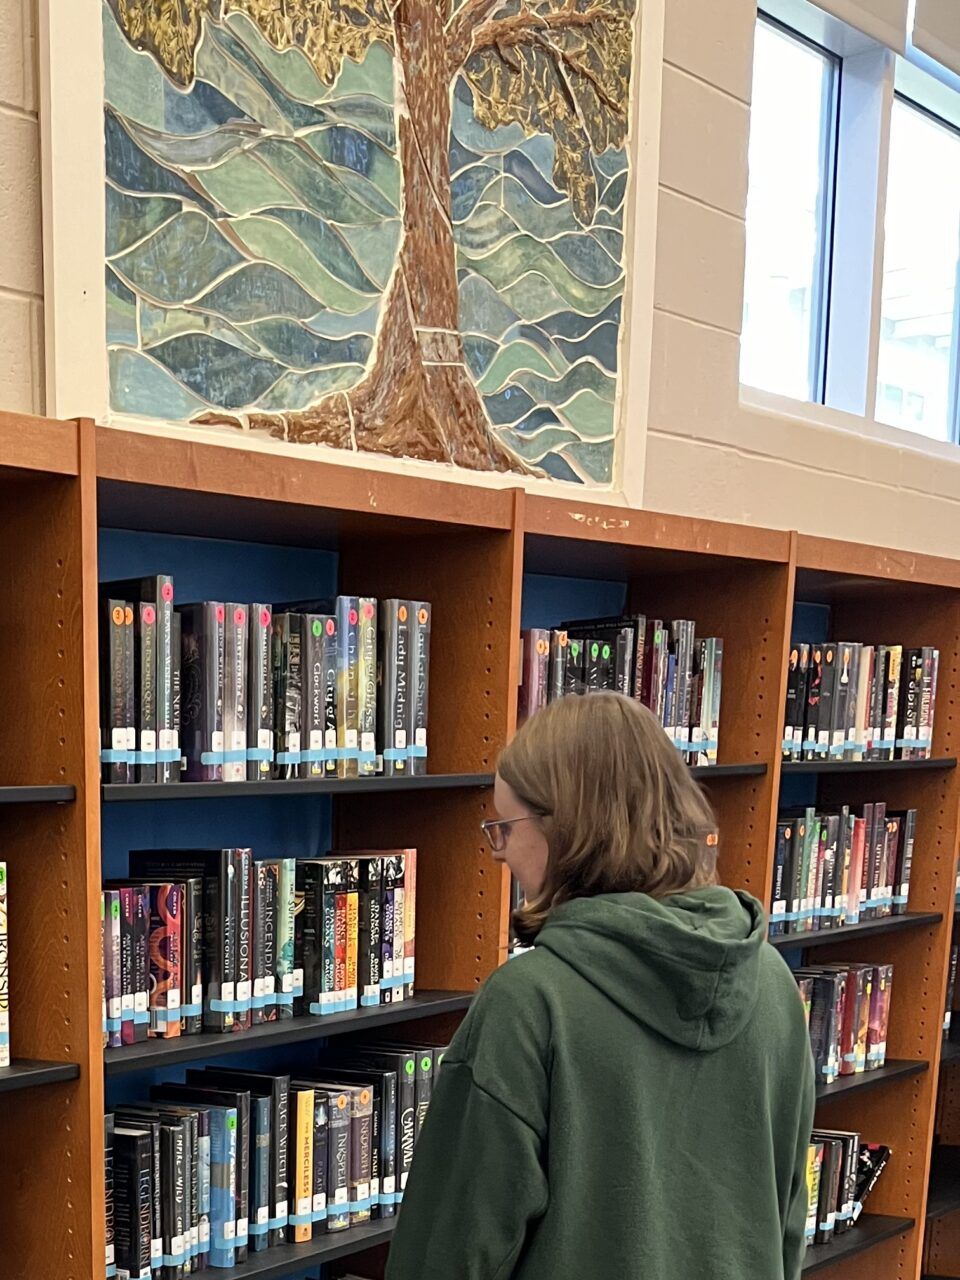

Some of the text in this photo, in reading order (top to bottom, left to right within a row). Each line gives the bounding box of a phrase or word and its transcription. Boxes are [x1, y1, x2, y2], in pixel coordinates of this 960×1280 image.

[365, 626, 375, 661] City
[396, 624, 406, 665] Lady
[173, 670, 181, 691] THE
[313, 662, 321, 726] Clockwork
[325, 669, 335, 702] City
[239, 895, 250, 982] ILLUSIONA
[264, 906, 274, 977] INCENDIA
[278, 1091, 288, 1131] BLACK
[401, 1107, 414, 1168] CARAVAL
[175, 1176, 184, 1204] WILD
[140, 1168, 151, 1266] LEGENDBORN
